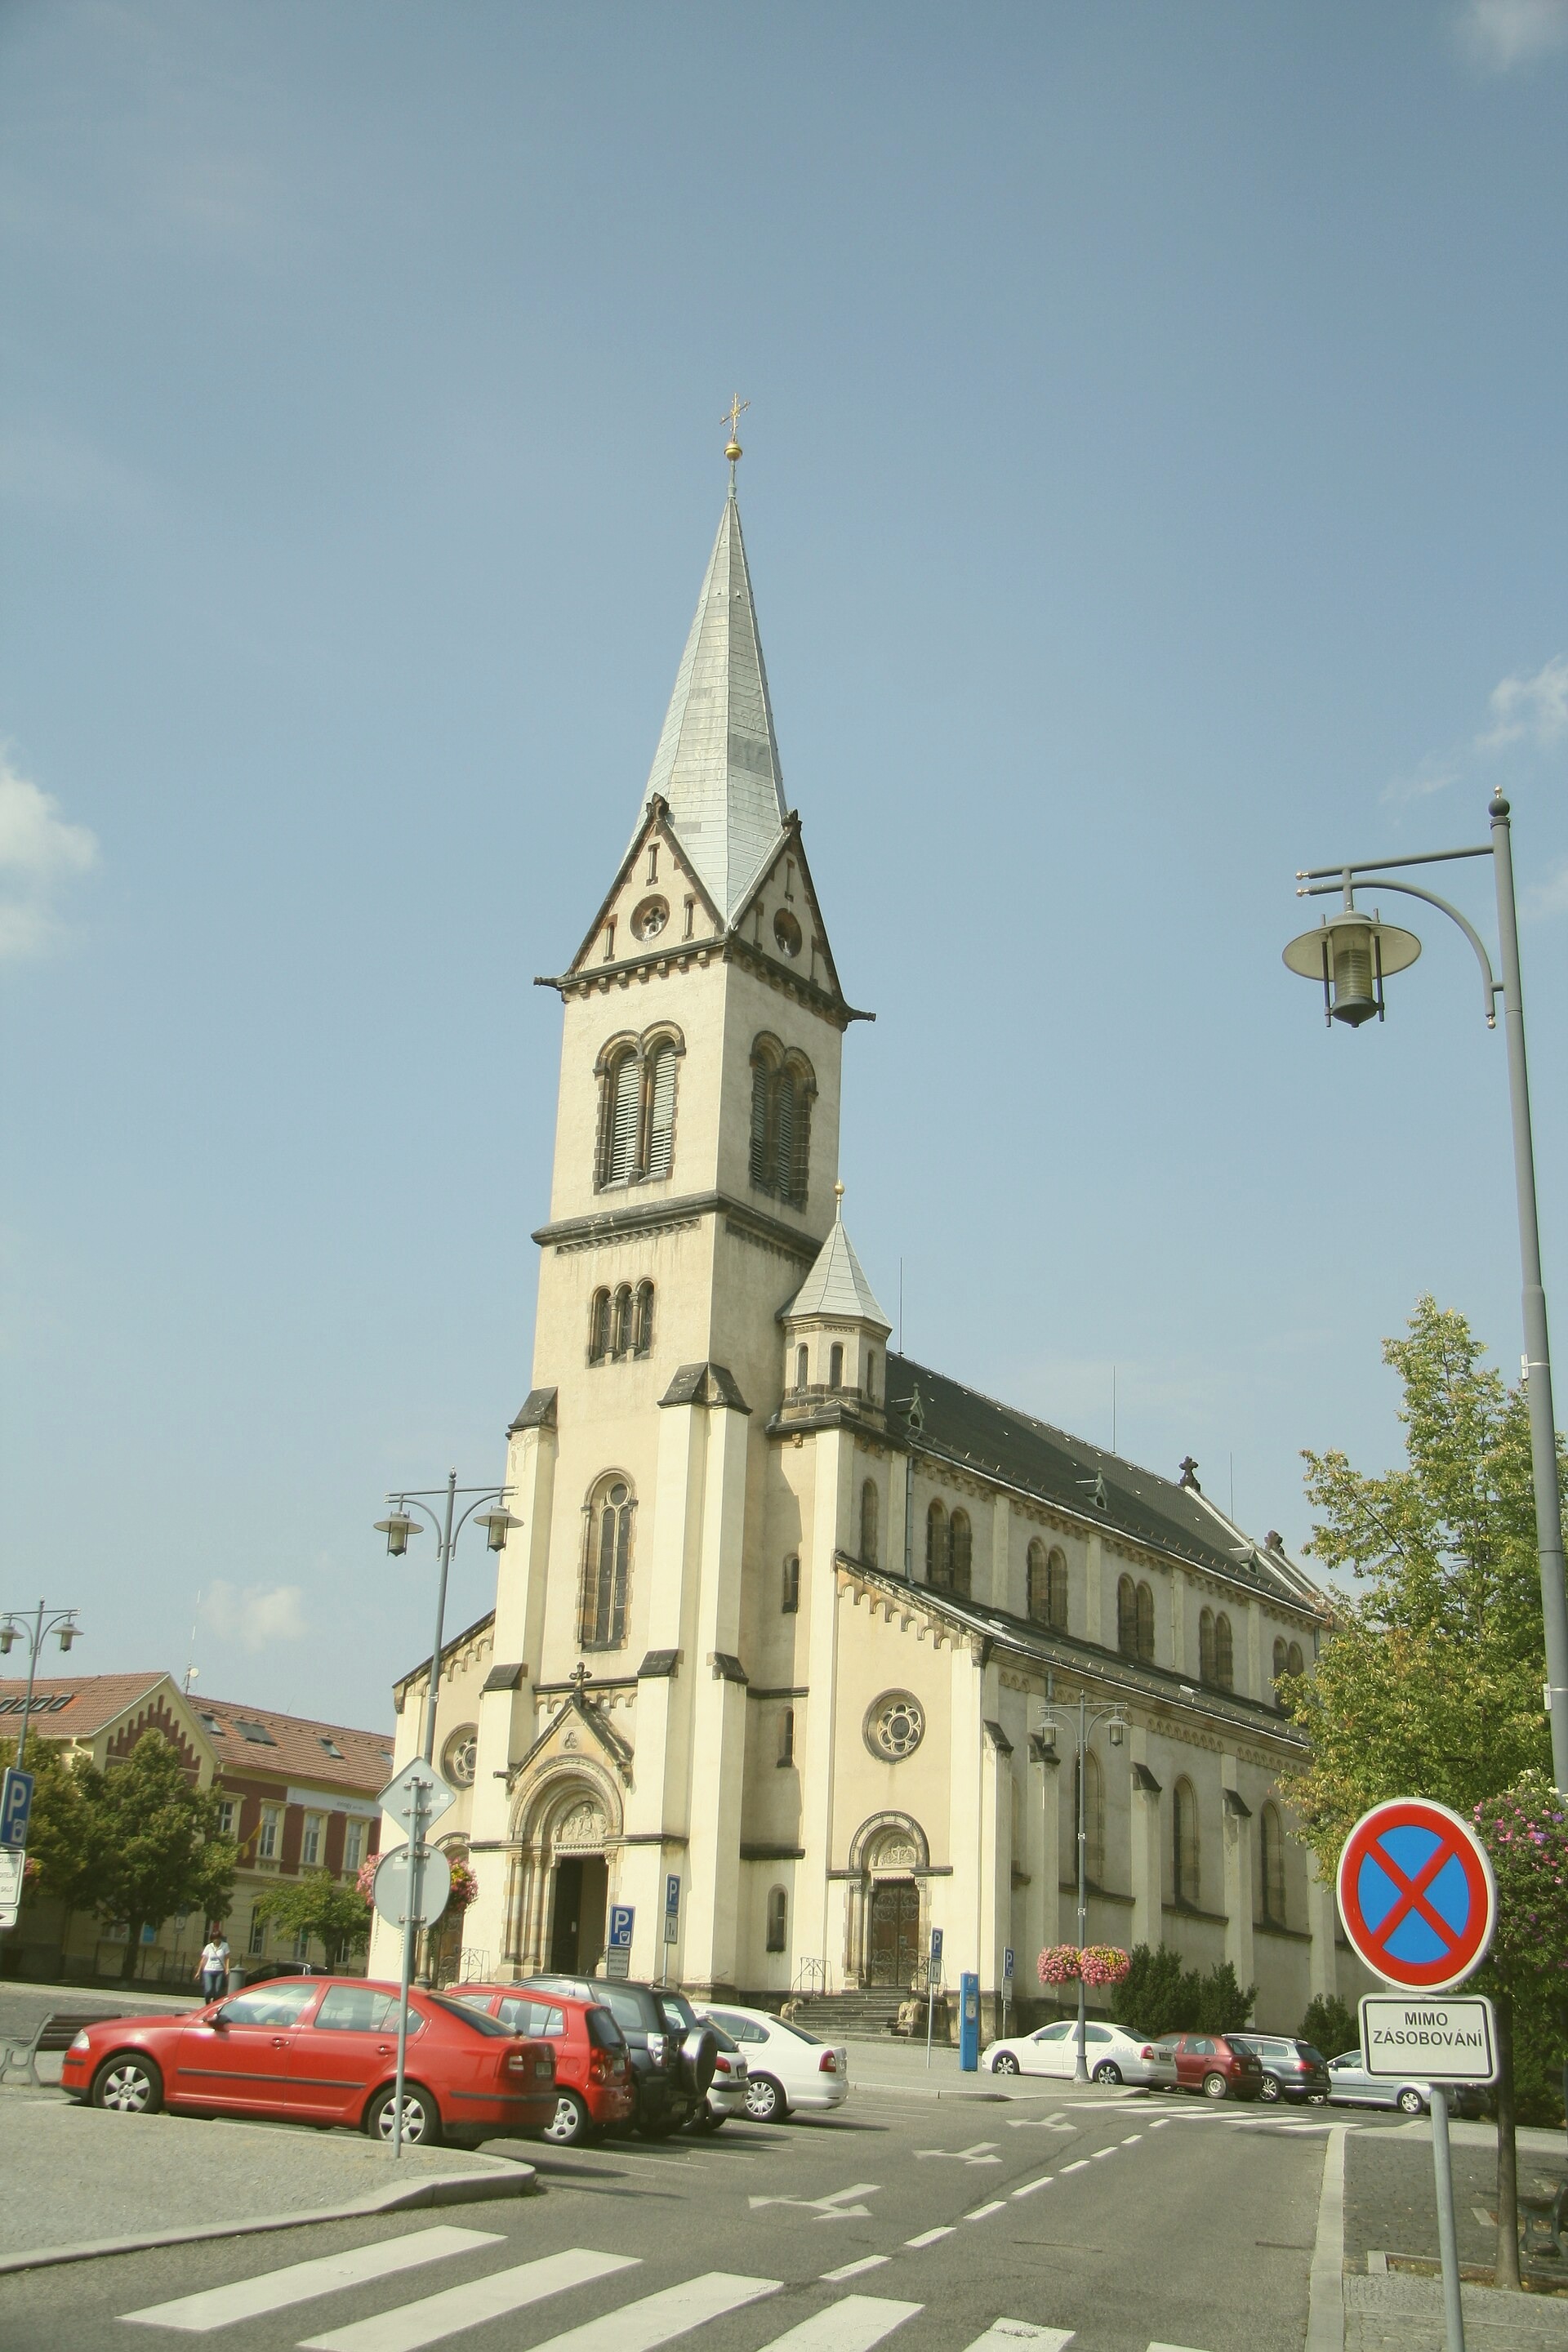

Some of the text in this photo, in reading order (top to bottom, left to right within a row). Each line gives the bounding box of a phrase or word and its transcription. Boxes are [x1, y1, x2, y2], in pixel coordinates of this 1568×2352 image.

[7, 1780, 27, 1822] P
[670, 1880, 677, 1901] P
[614, 1910, 630, 1934] P
[933, 1932, 941, 1949] P
[968, 1977, 973, 1985] P
[1404, 2011, 1448, 2026] MIMO
[1373, 2027, 1482, 2047] ZÁSOBOVÁNÍ
